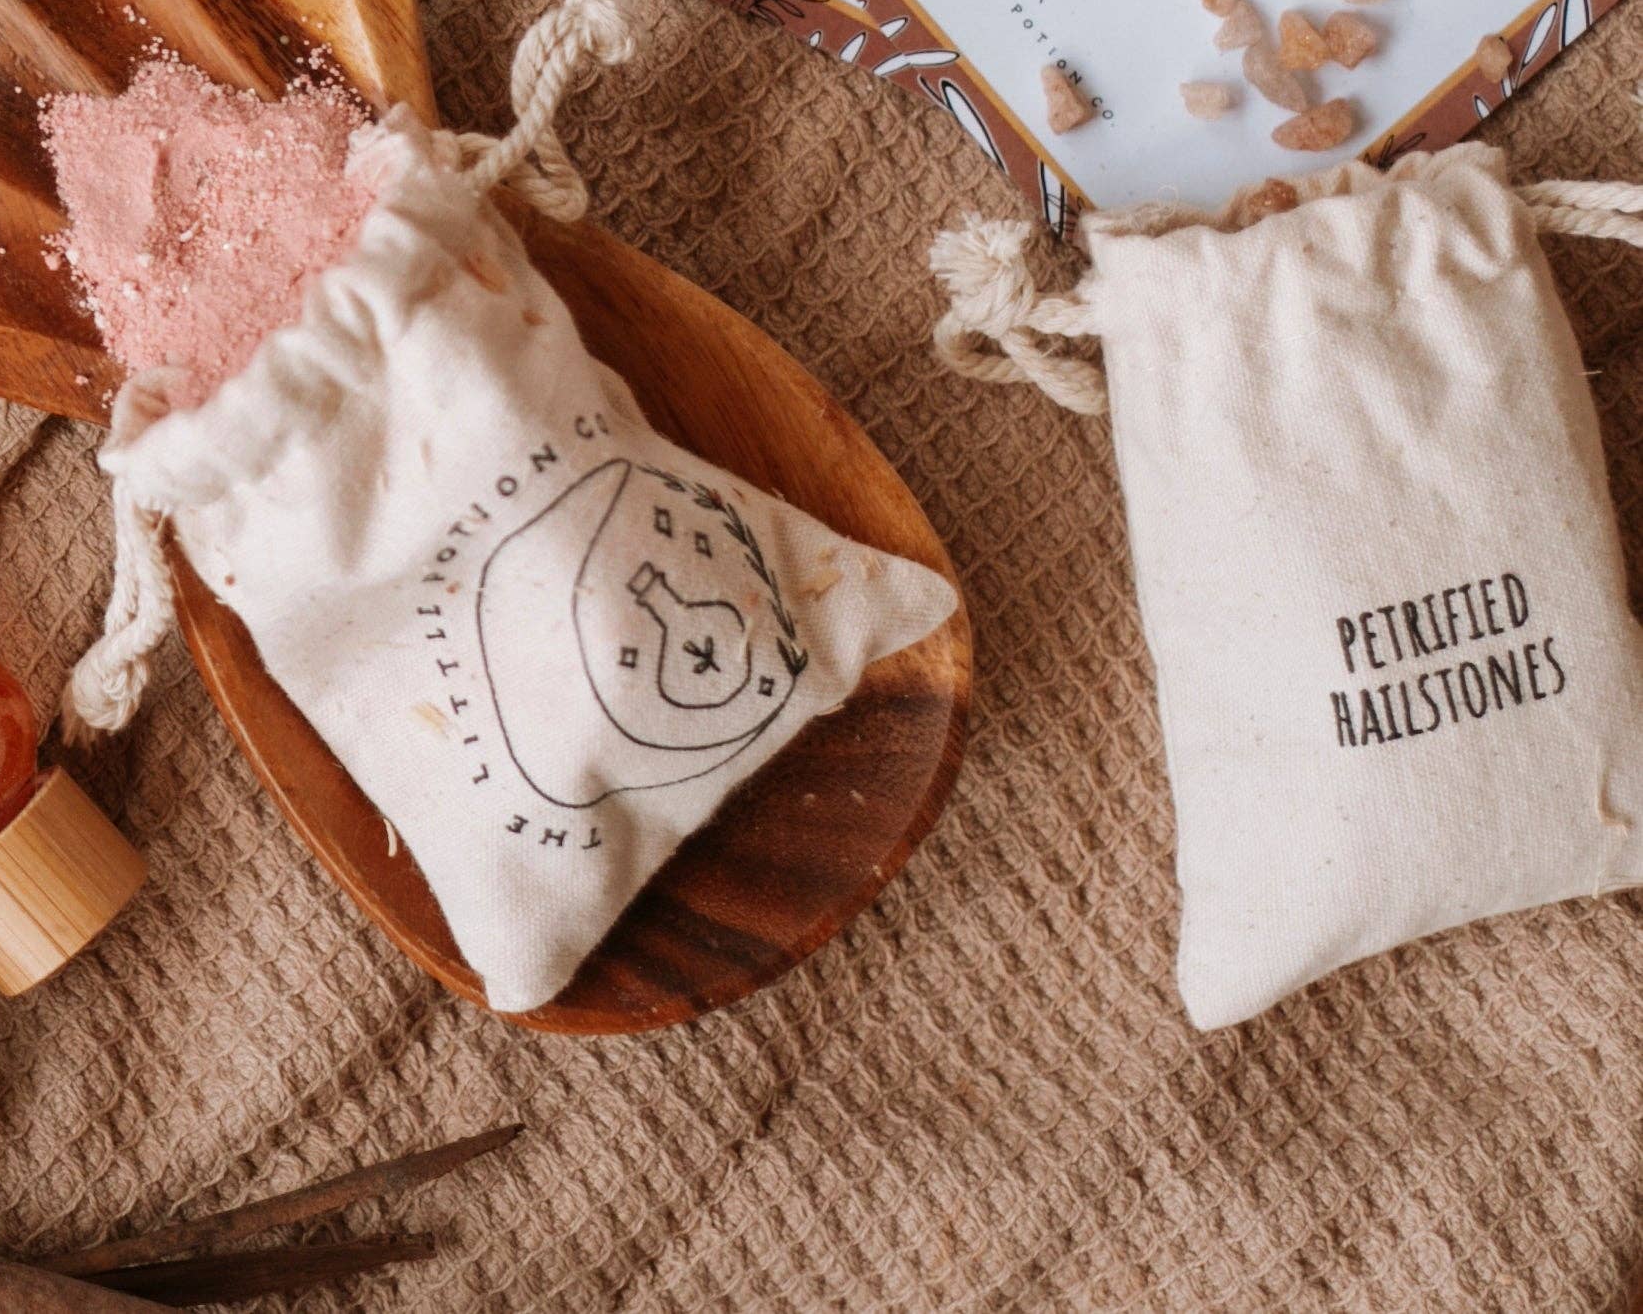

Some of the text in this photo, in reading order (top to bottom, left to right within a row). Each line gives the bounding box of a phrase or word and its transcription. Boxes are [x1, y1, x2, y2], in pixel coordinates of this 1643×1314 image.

[1010, 3, 1083, 85] POTION
[421, 442, 558, 583] POTION
[1336, 572, 1530, 674] PETRIFIED
[416, 603, 491, 785] LITTLE
[1329, 636, 1566, 748] HAILSTONES
[506, 813, 602, 850] THE
